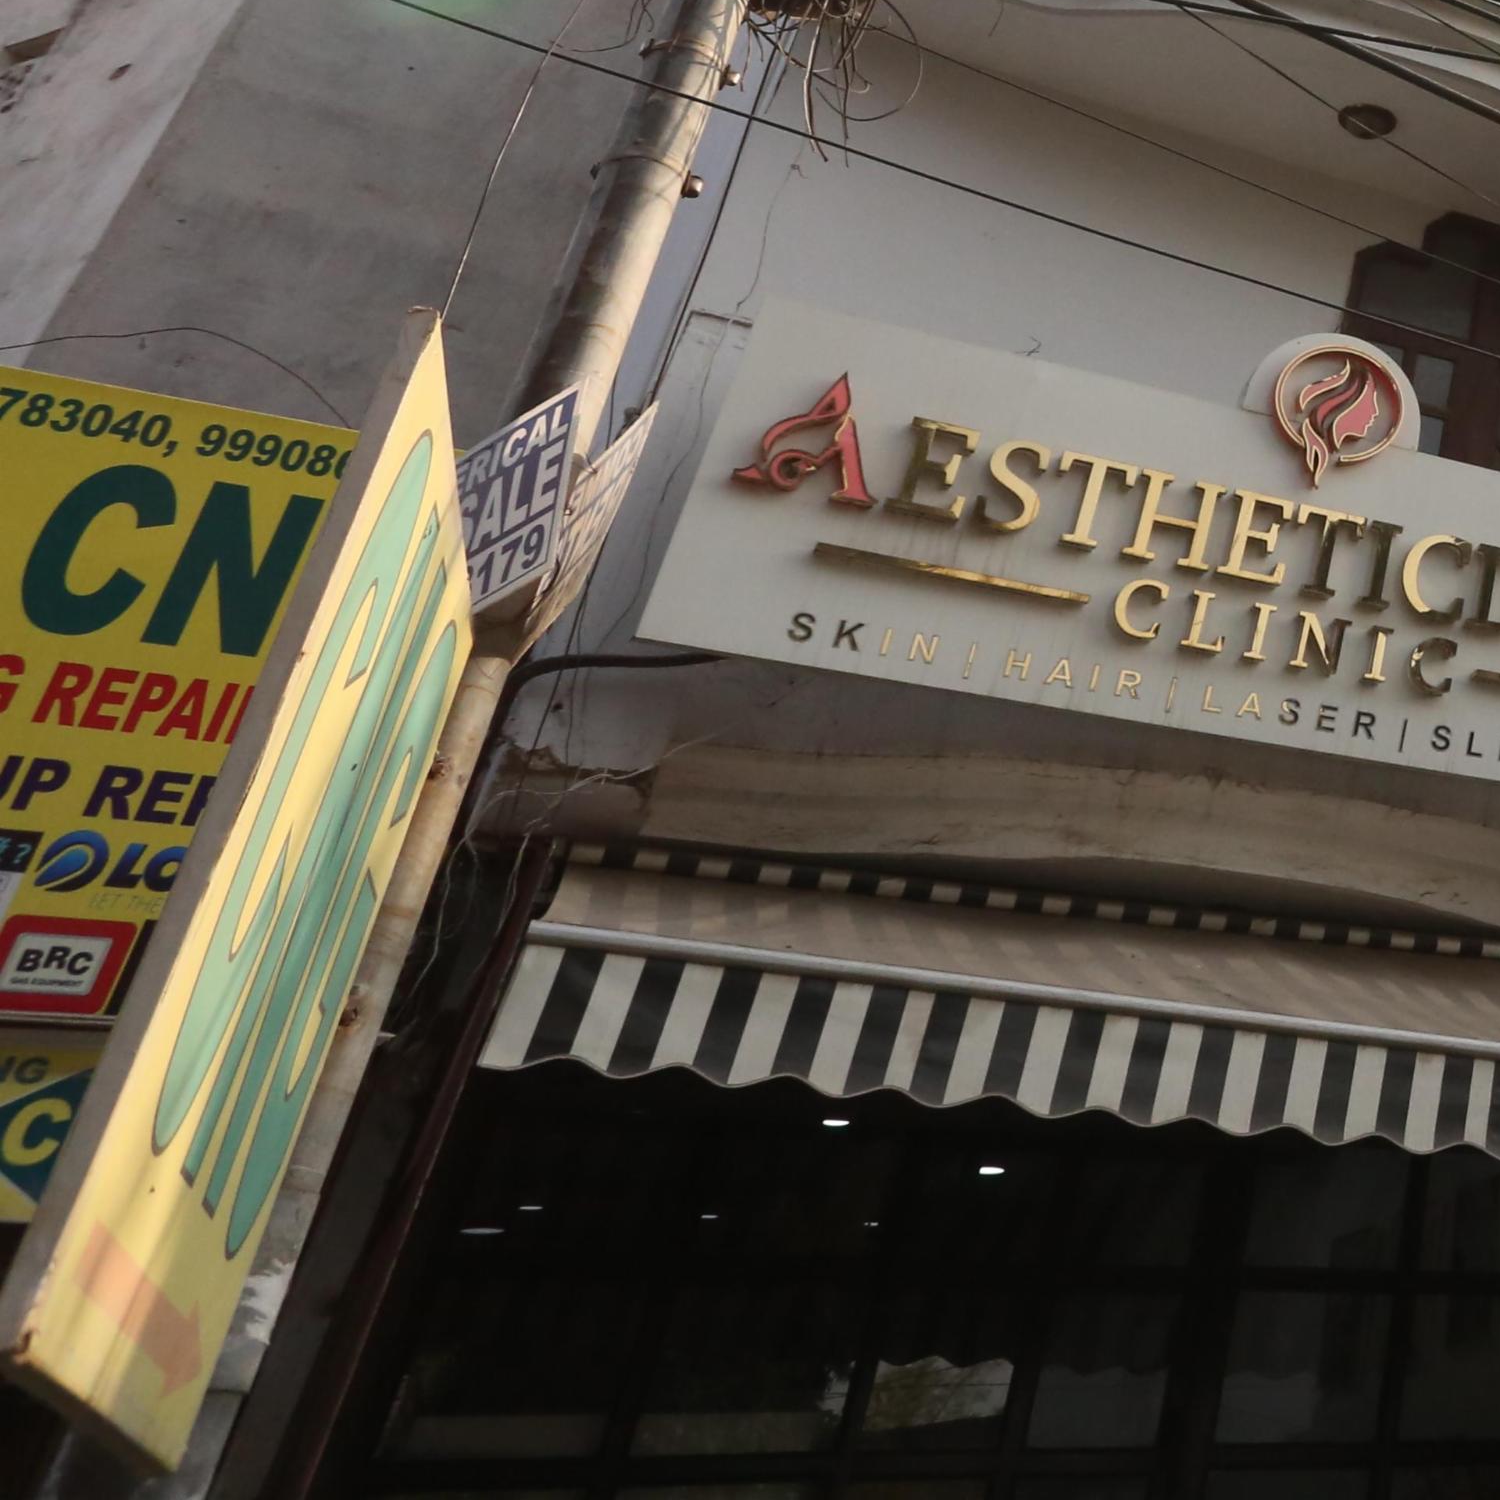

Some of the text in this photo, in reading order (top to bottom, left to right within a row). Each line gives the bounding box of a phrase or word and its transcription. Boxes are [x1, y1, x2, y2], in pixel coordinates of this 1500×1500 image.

[467, 523, 545, 596] 179
[787, 611, 941, 664] SKIN
[1003, 649, 1142, 698] HAIR
[1201, 683, 1377, 739] LASER
[1114, 578, 1458, 697] CLINIC
[17, 946, 94, 975] BRC
